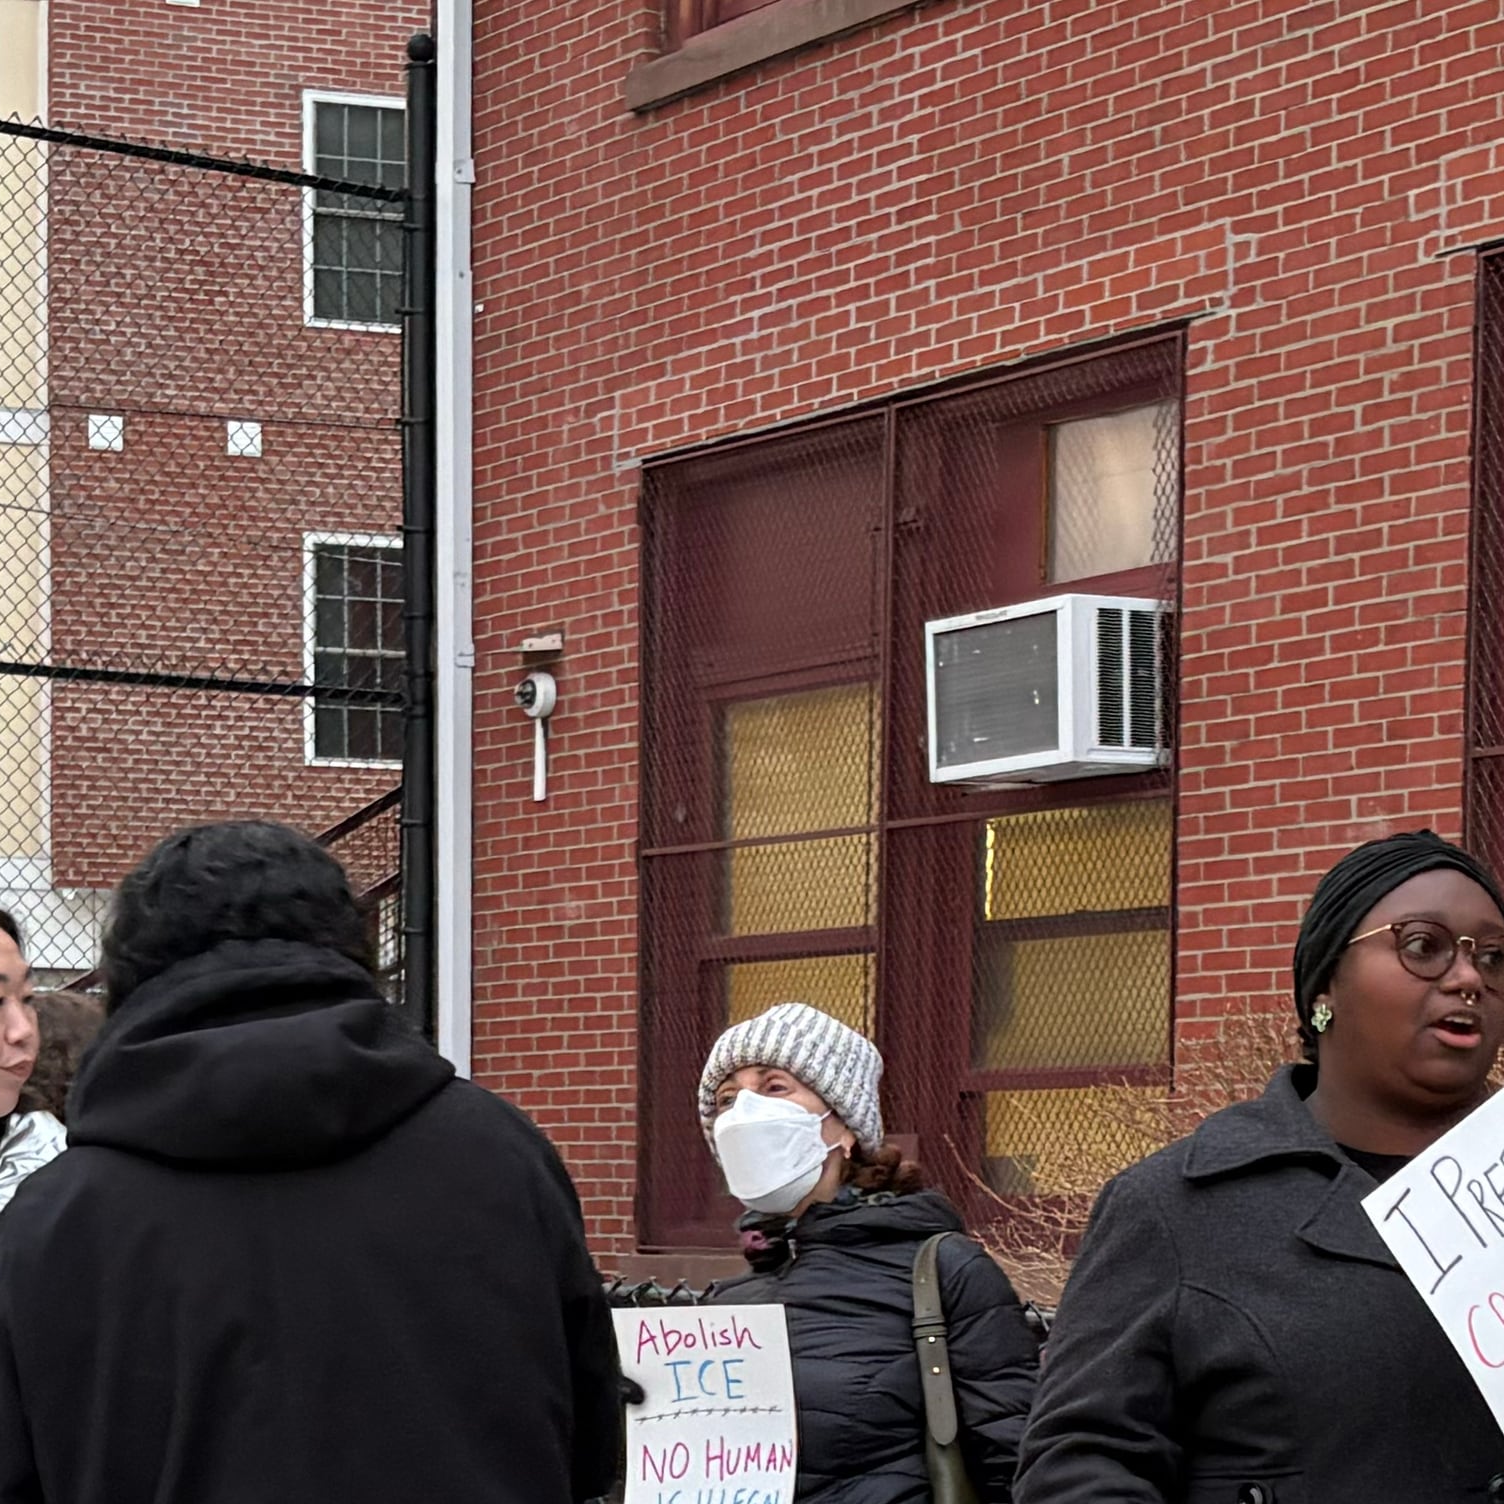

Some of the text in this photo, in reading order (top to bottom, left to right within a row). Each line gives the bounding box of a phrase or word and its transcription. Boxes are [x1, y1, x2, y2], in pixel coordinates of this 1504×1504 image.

[1384, 1188, 1463, 1295] I
[636, 1315, 763, 1364] Abolish
[663, 1358, 745, 1404] ICE
[642, 1435, 793, 1484] NO HUMAN
